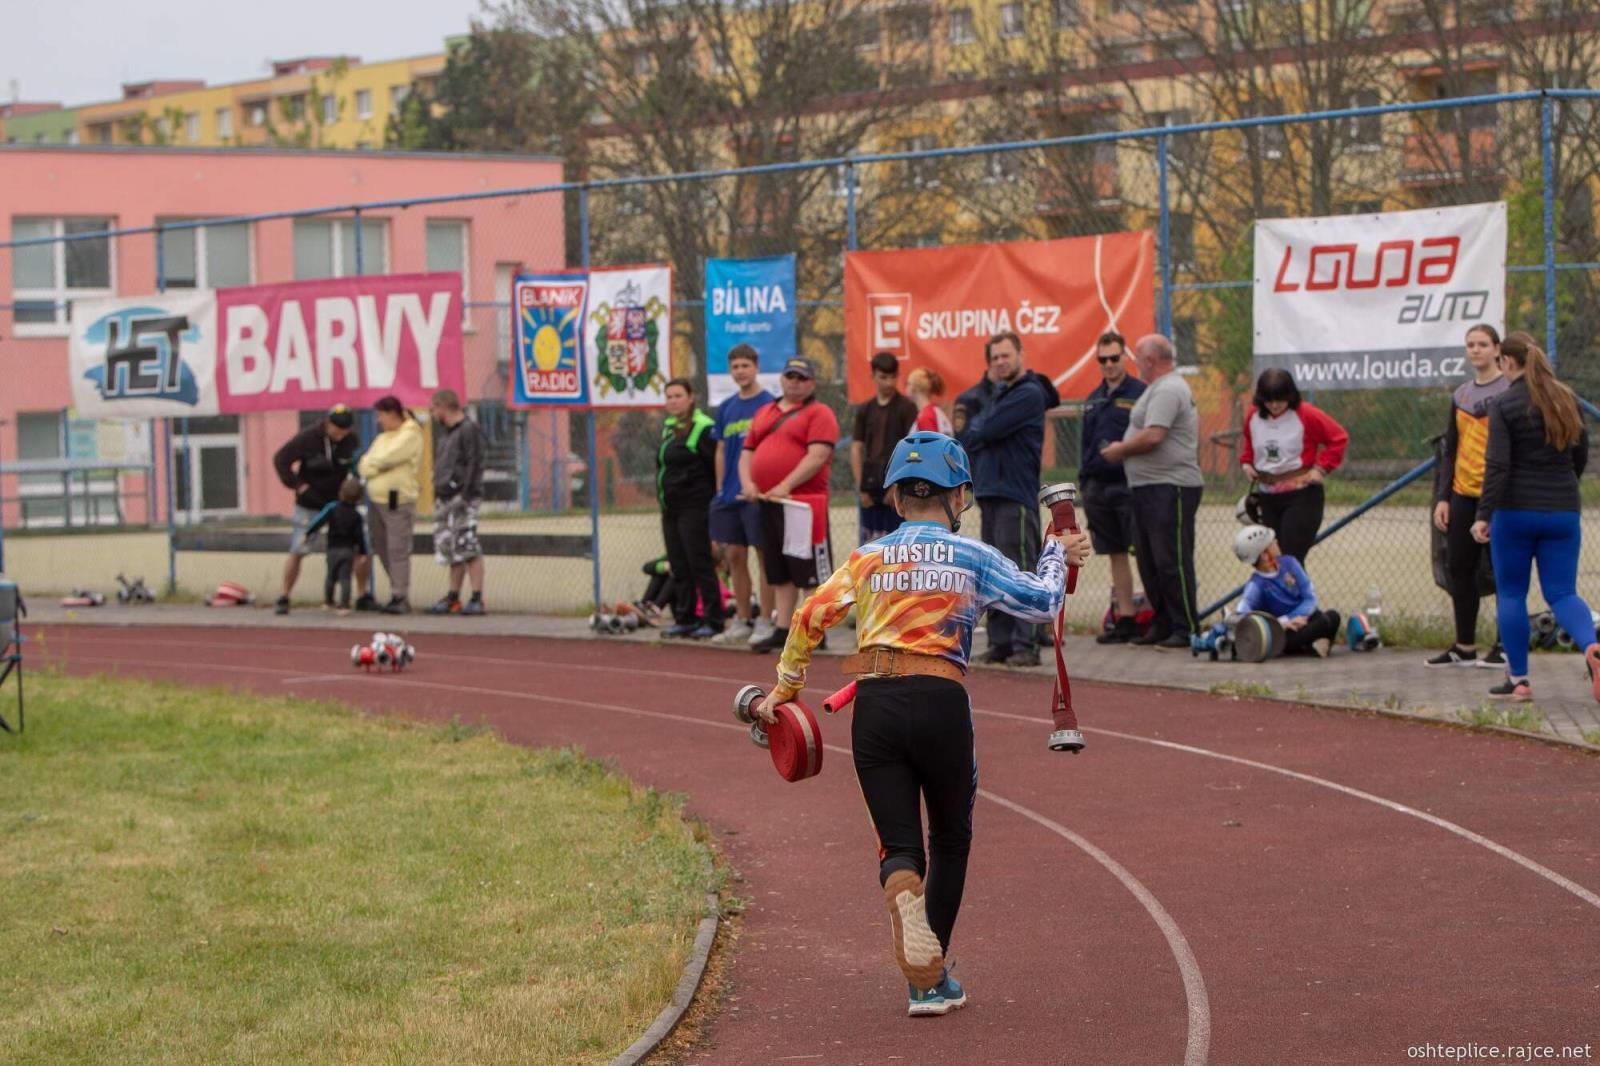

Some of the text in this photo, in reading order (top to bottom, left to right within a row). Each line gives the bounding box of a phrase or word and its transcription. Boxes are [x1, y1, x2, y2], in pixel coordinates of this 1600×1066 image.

[712, 279, 787, 316] BÍLINA
[917, 300, 1061, 340] SKUPINA ČEZ
[105, 315, 189, 394] HET
[226, 291, 451, 396] BARVY
[1294, 353, 1466, 381] www.louda.cz
[882, 540, 955, 564] HASIČI
[870, 569, 967, 594] DUCHCOV
